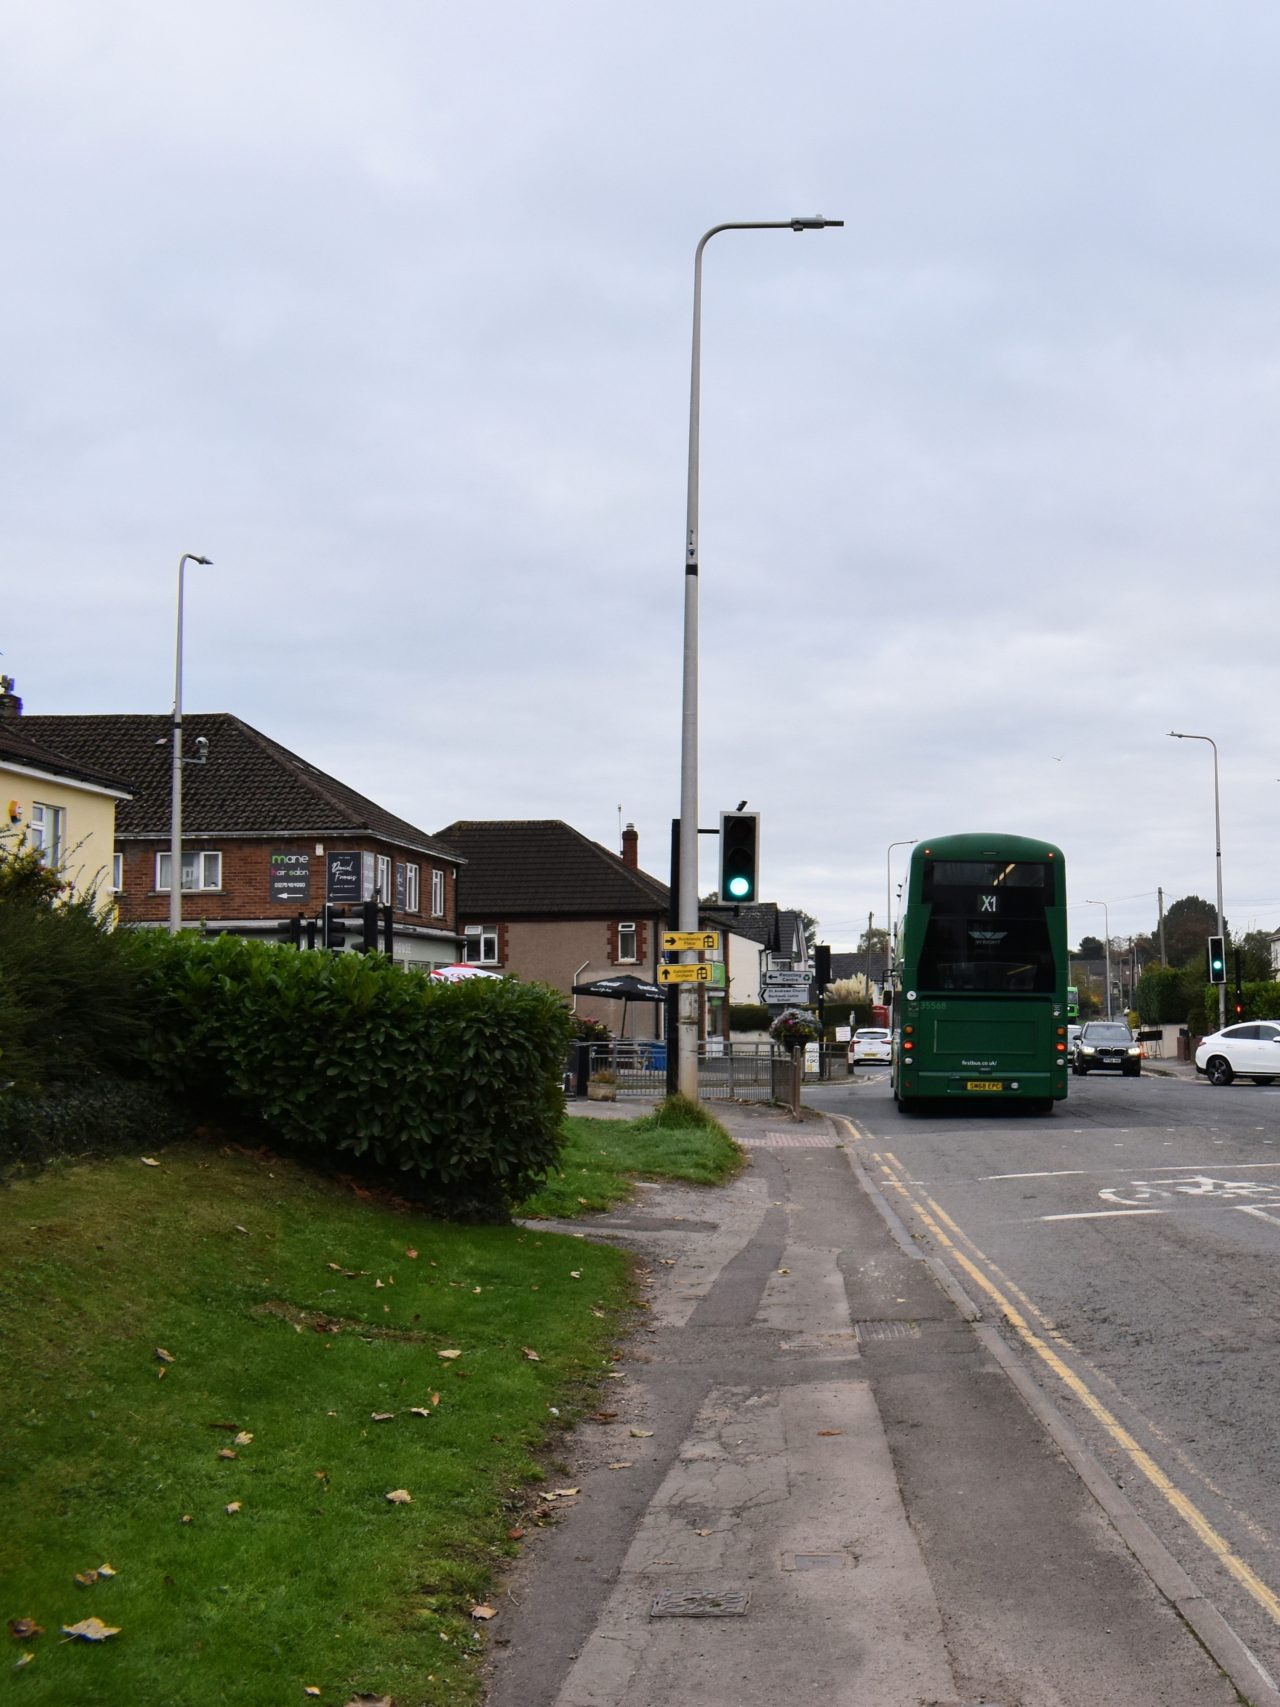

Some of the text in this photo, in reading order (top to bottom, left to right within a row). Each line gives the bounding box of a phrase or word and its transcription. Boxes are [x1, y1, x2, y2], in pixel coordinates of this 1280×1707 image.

[272, 855, 308, 863] mane
[272, 867, 308, 876] hair salon
[981, 895, 996, 911] X1
[920, 1002, 947, 1010] 35568
